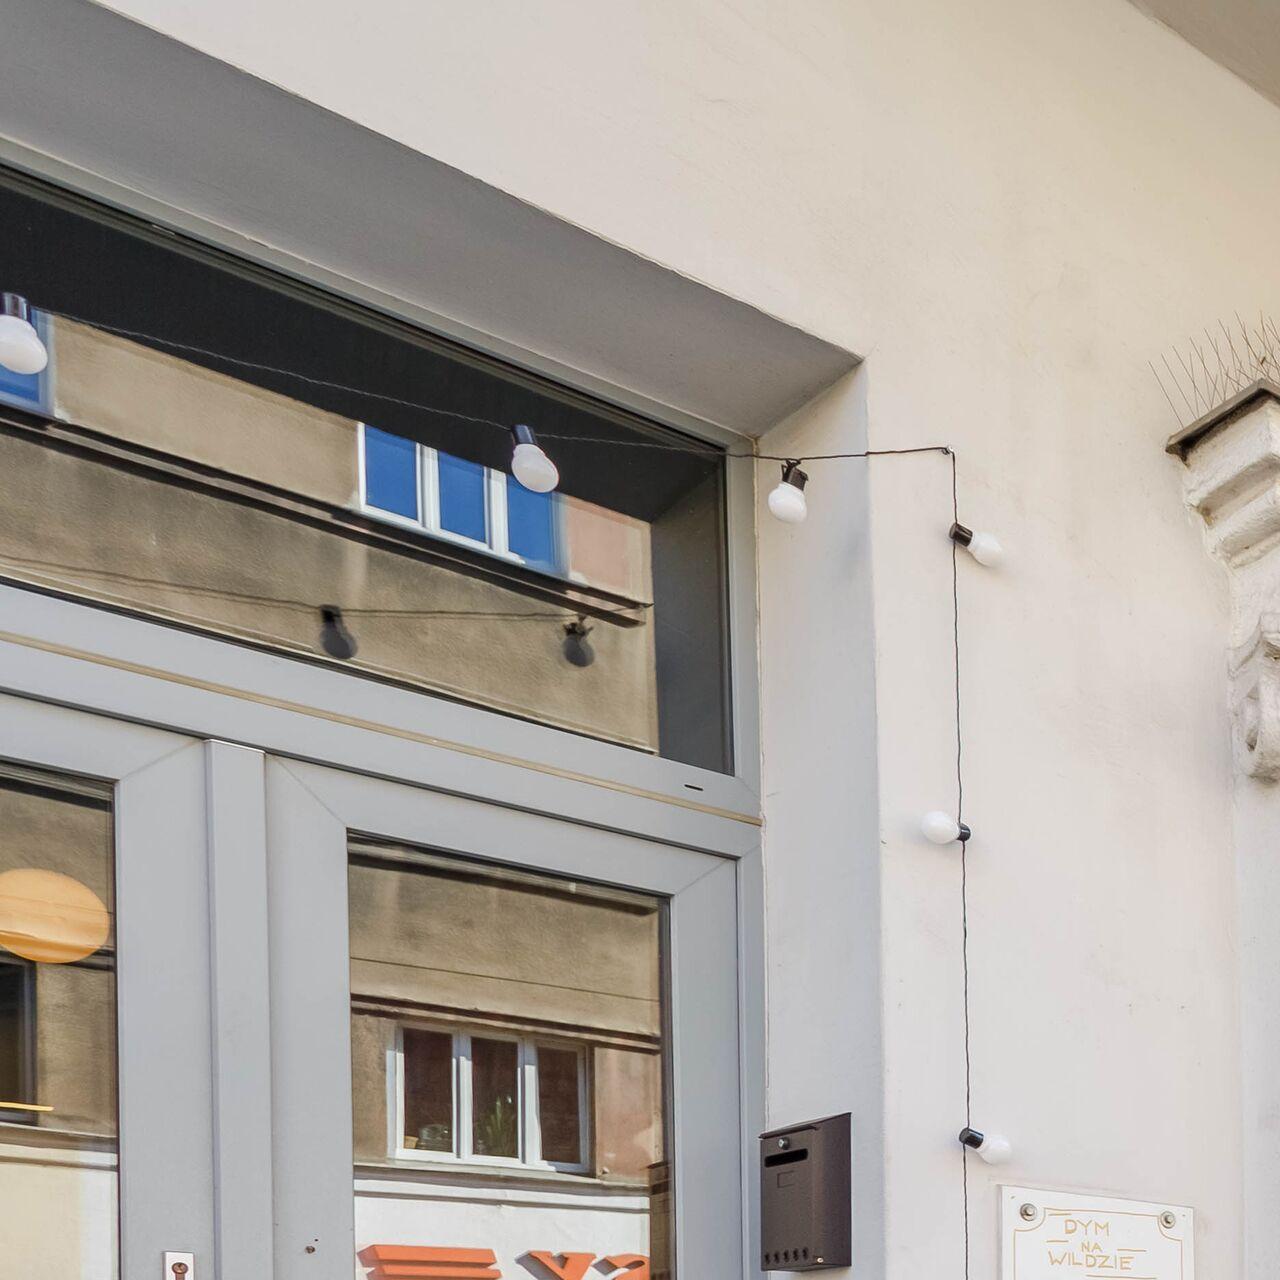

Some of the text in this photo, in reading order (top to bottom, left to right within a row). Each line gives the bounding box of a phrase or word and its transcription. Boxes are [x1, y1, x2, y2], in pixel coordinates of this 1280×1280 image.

[1063, 1218, 1110, 1237] DYM
[1080, 1240, 1104, 1253] NA
[1047, 1250, 1135, 1271] WILDZIE
